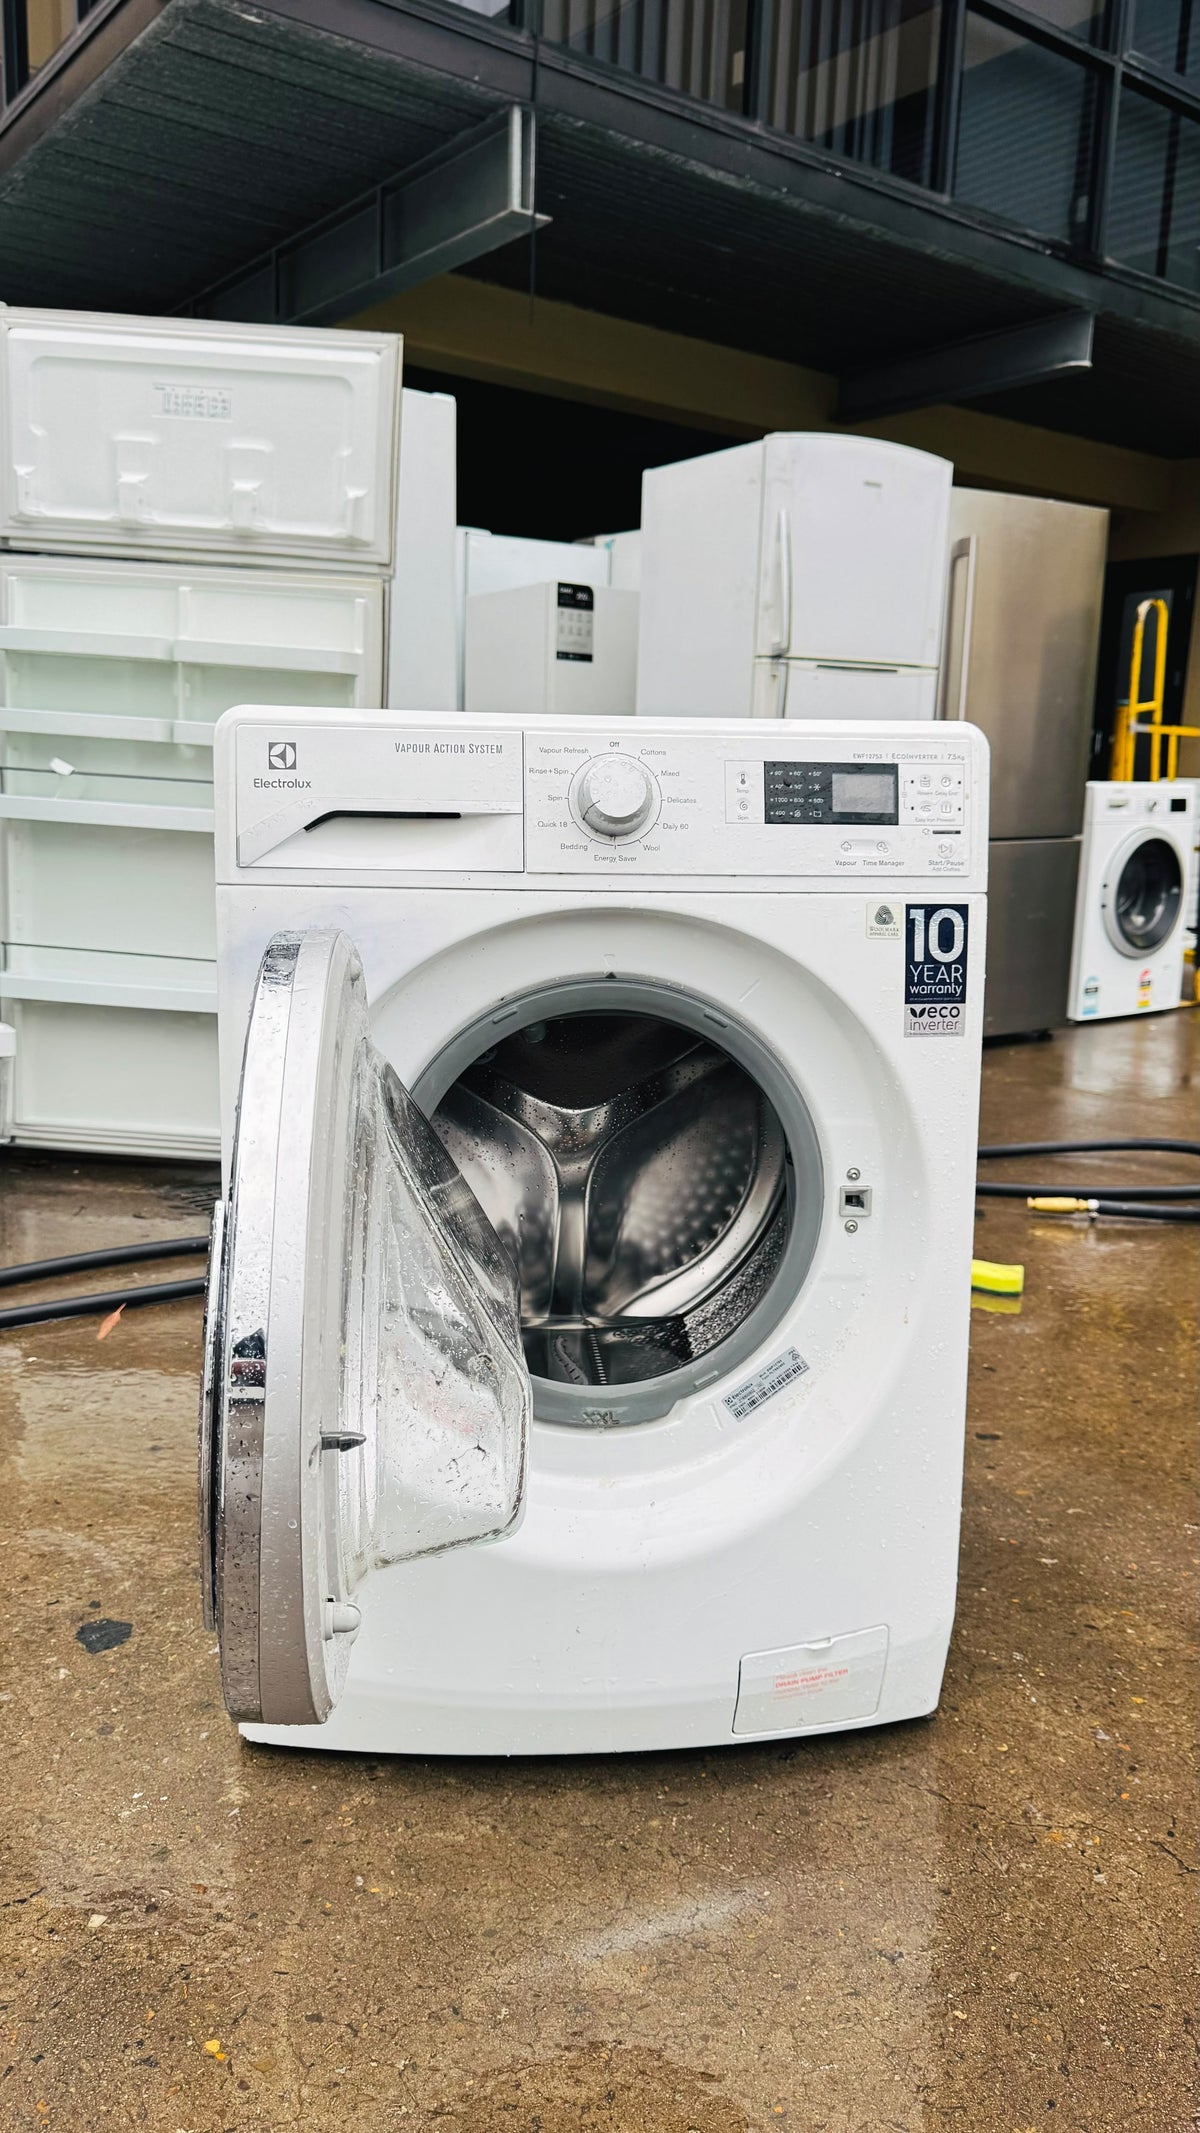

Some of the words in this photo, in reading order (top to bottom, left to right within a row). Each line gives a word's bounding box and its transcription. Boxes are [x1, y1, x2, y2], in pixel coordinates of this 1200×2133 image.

[253, 778, 312, 789] Electrolux
[663, 823, 678, 831] Daily
[560, 843, 588, 852] Bedding
[594, 855, 616, 863] Energy
[909, 908, 964, 962] 10
[909, 964, 963, 983] YEAR
[909, 983, 963, 996] warranty
[927, 1006, 960, 1018] eco
[910, 1019, 960, 1031] inverter
[582, 1411, 620, 1425] XXL
